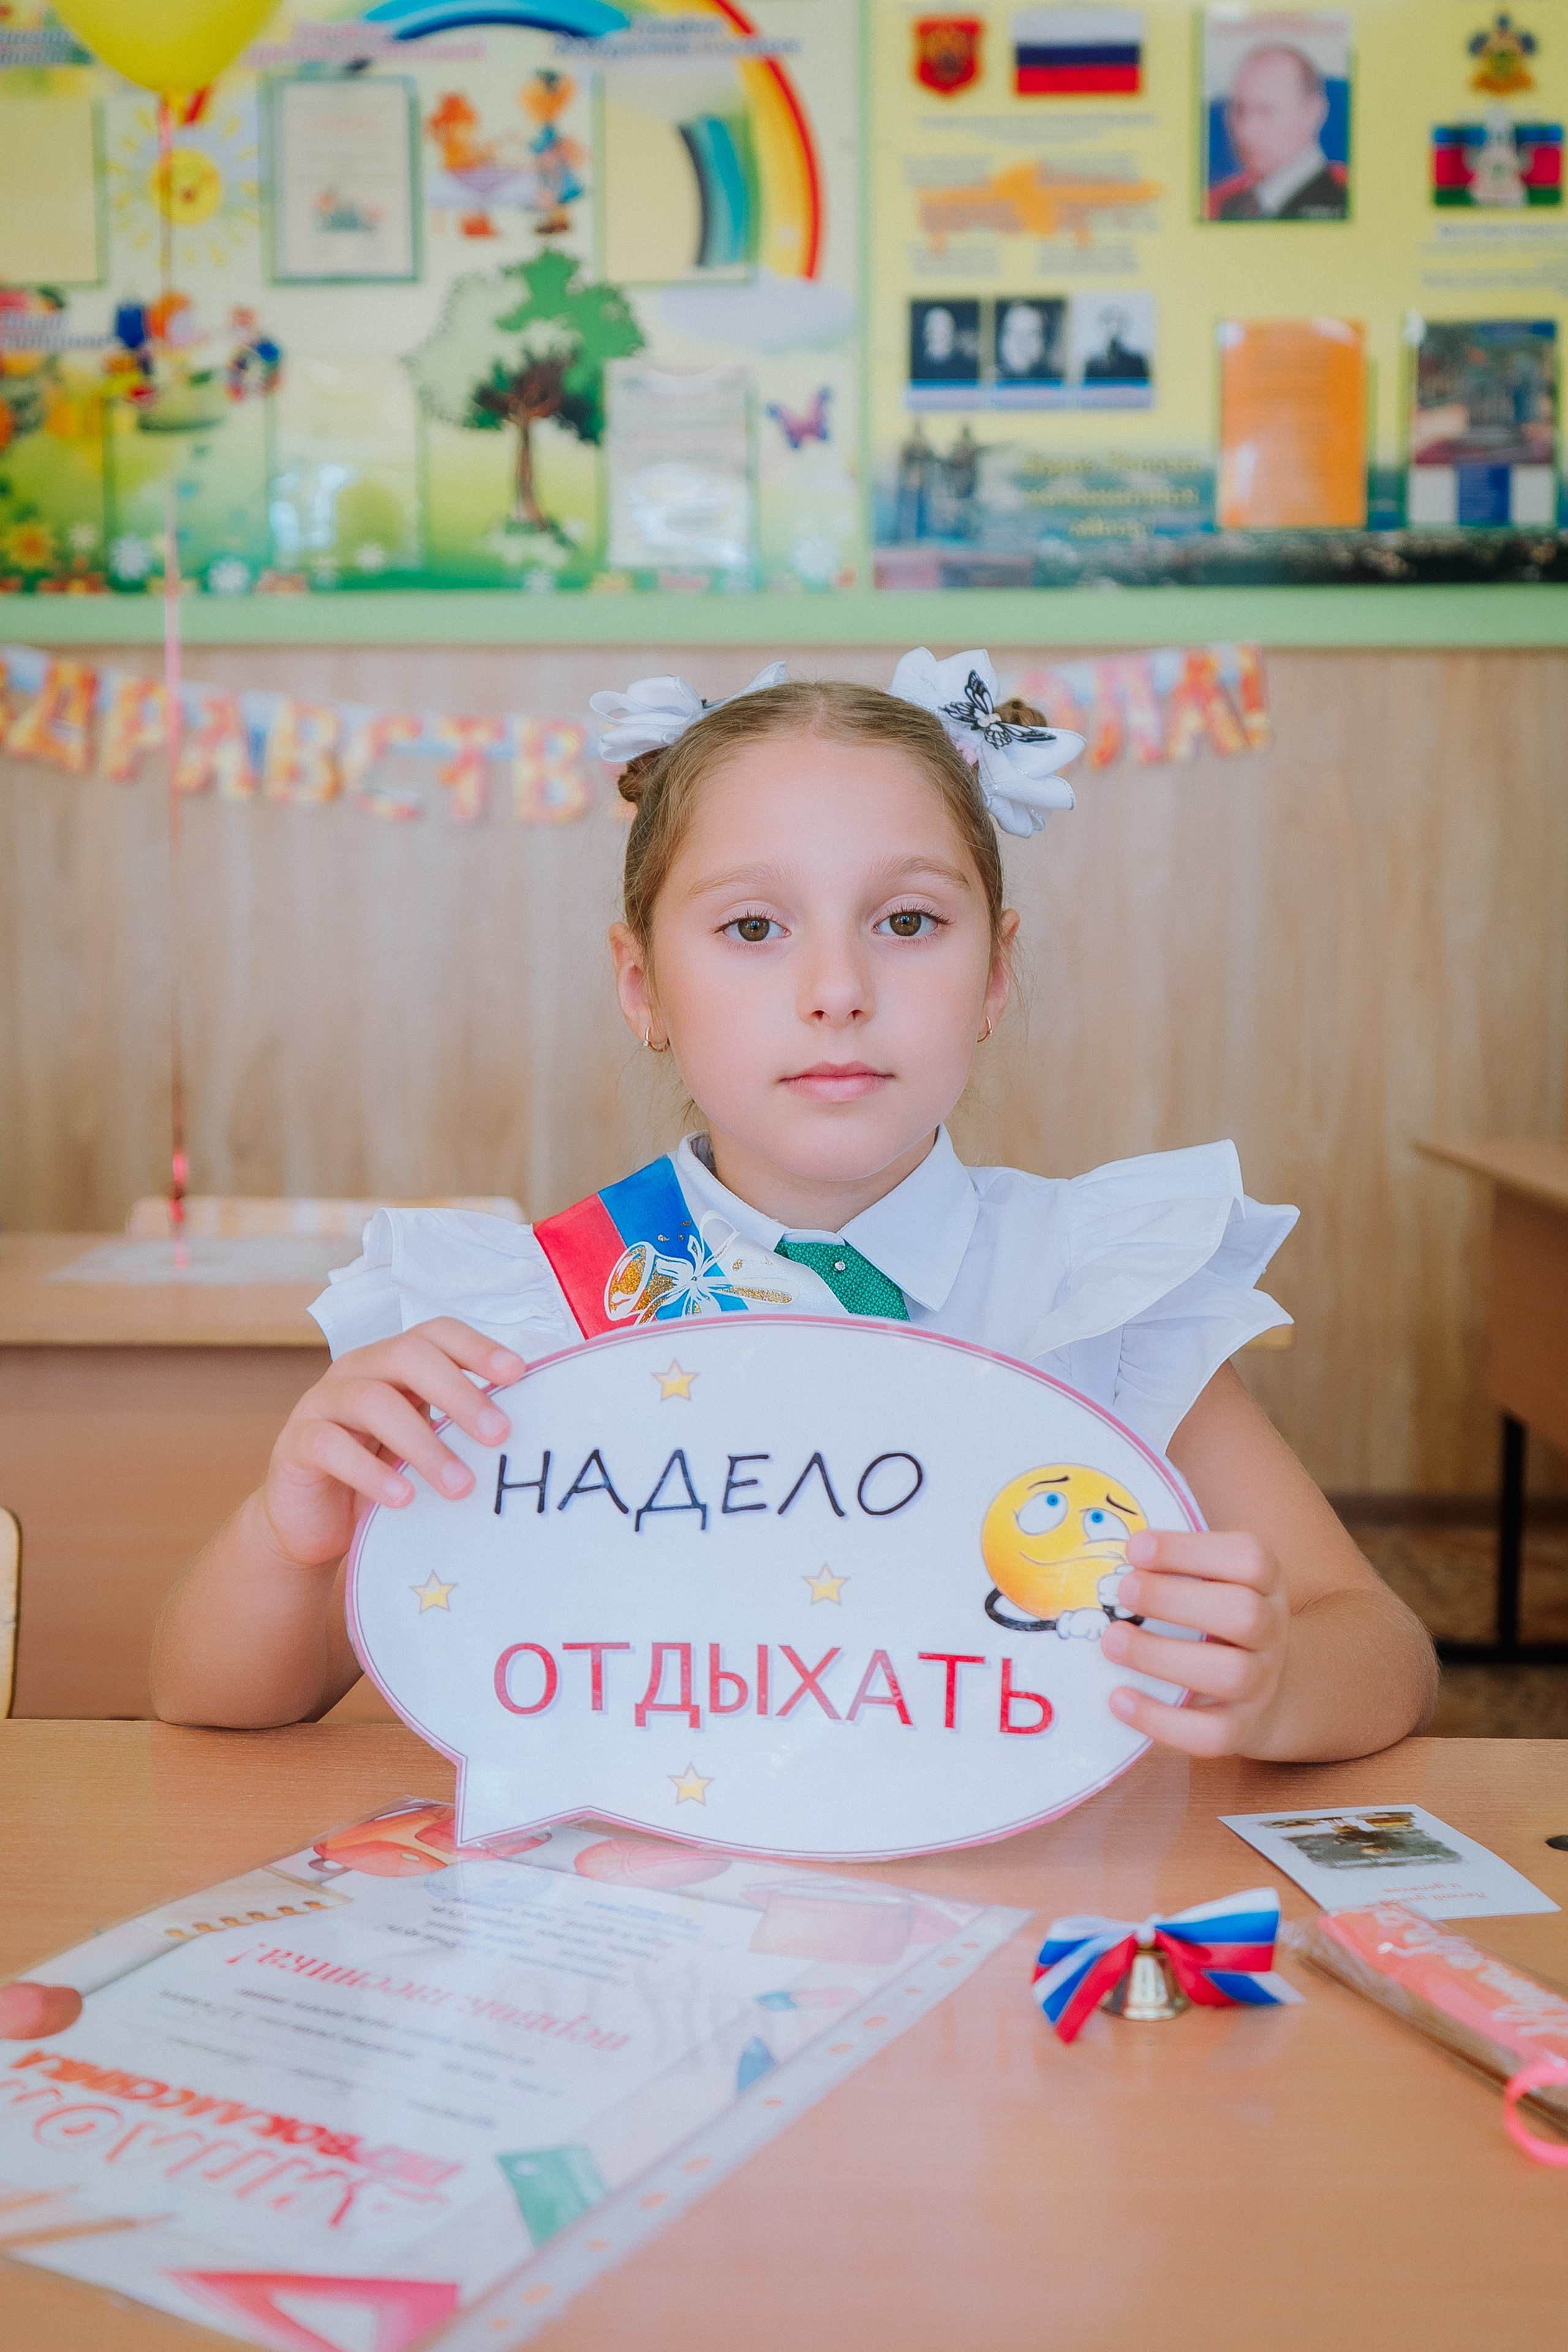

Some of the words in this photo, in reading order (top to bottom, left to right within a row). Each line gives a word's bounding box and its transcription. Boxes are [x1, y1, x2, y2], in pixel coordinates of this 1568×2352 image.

[0, 646, 635, 824] ДРАВСТВ
[492, 1447, 924, 1532] НАДЕЛО
[492, 1642, 1056, 1735] ОТДЫХАТЬ
[9, 2049, 467, 2188] ПЕРВОКЛАССНИКА
